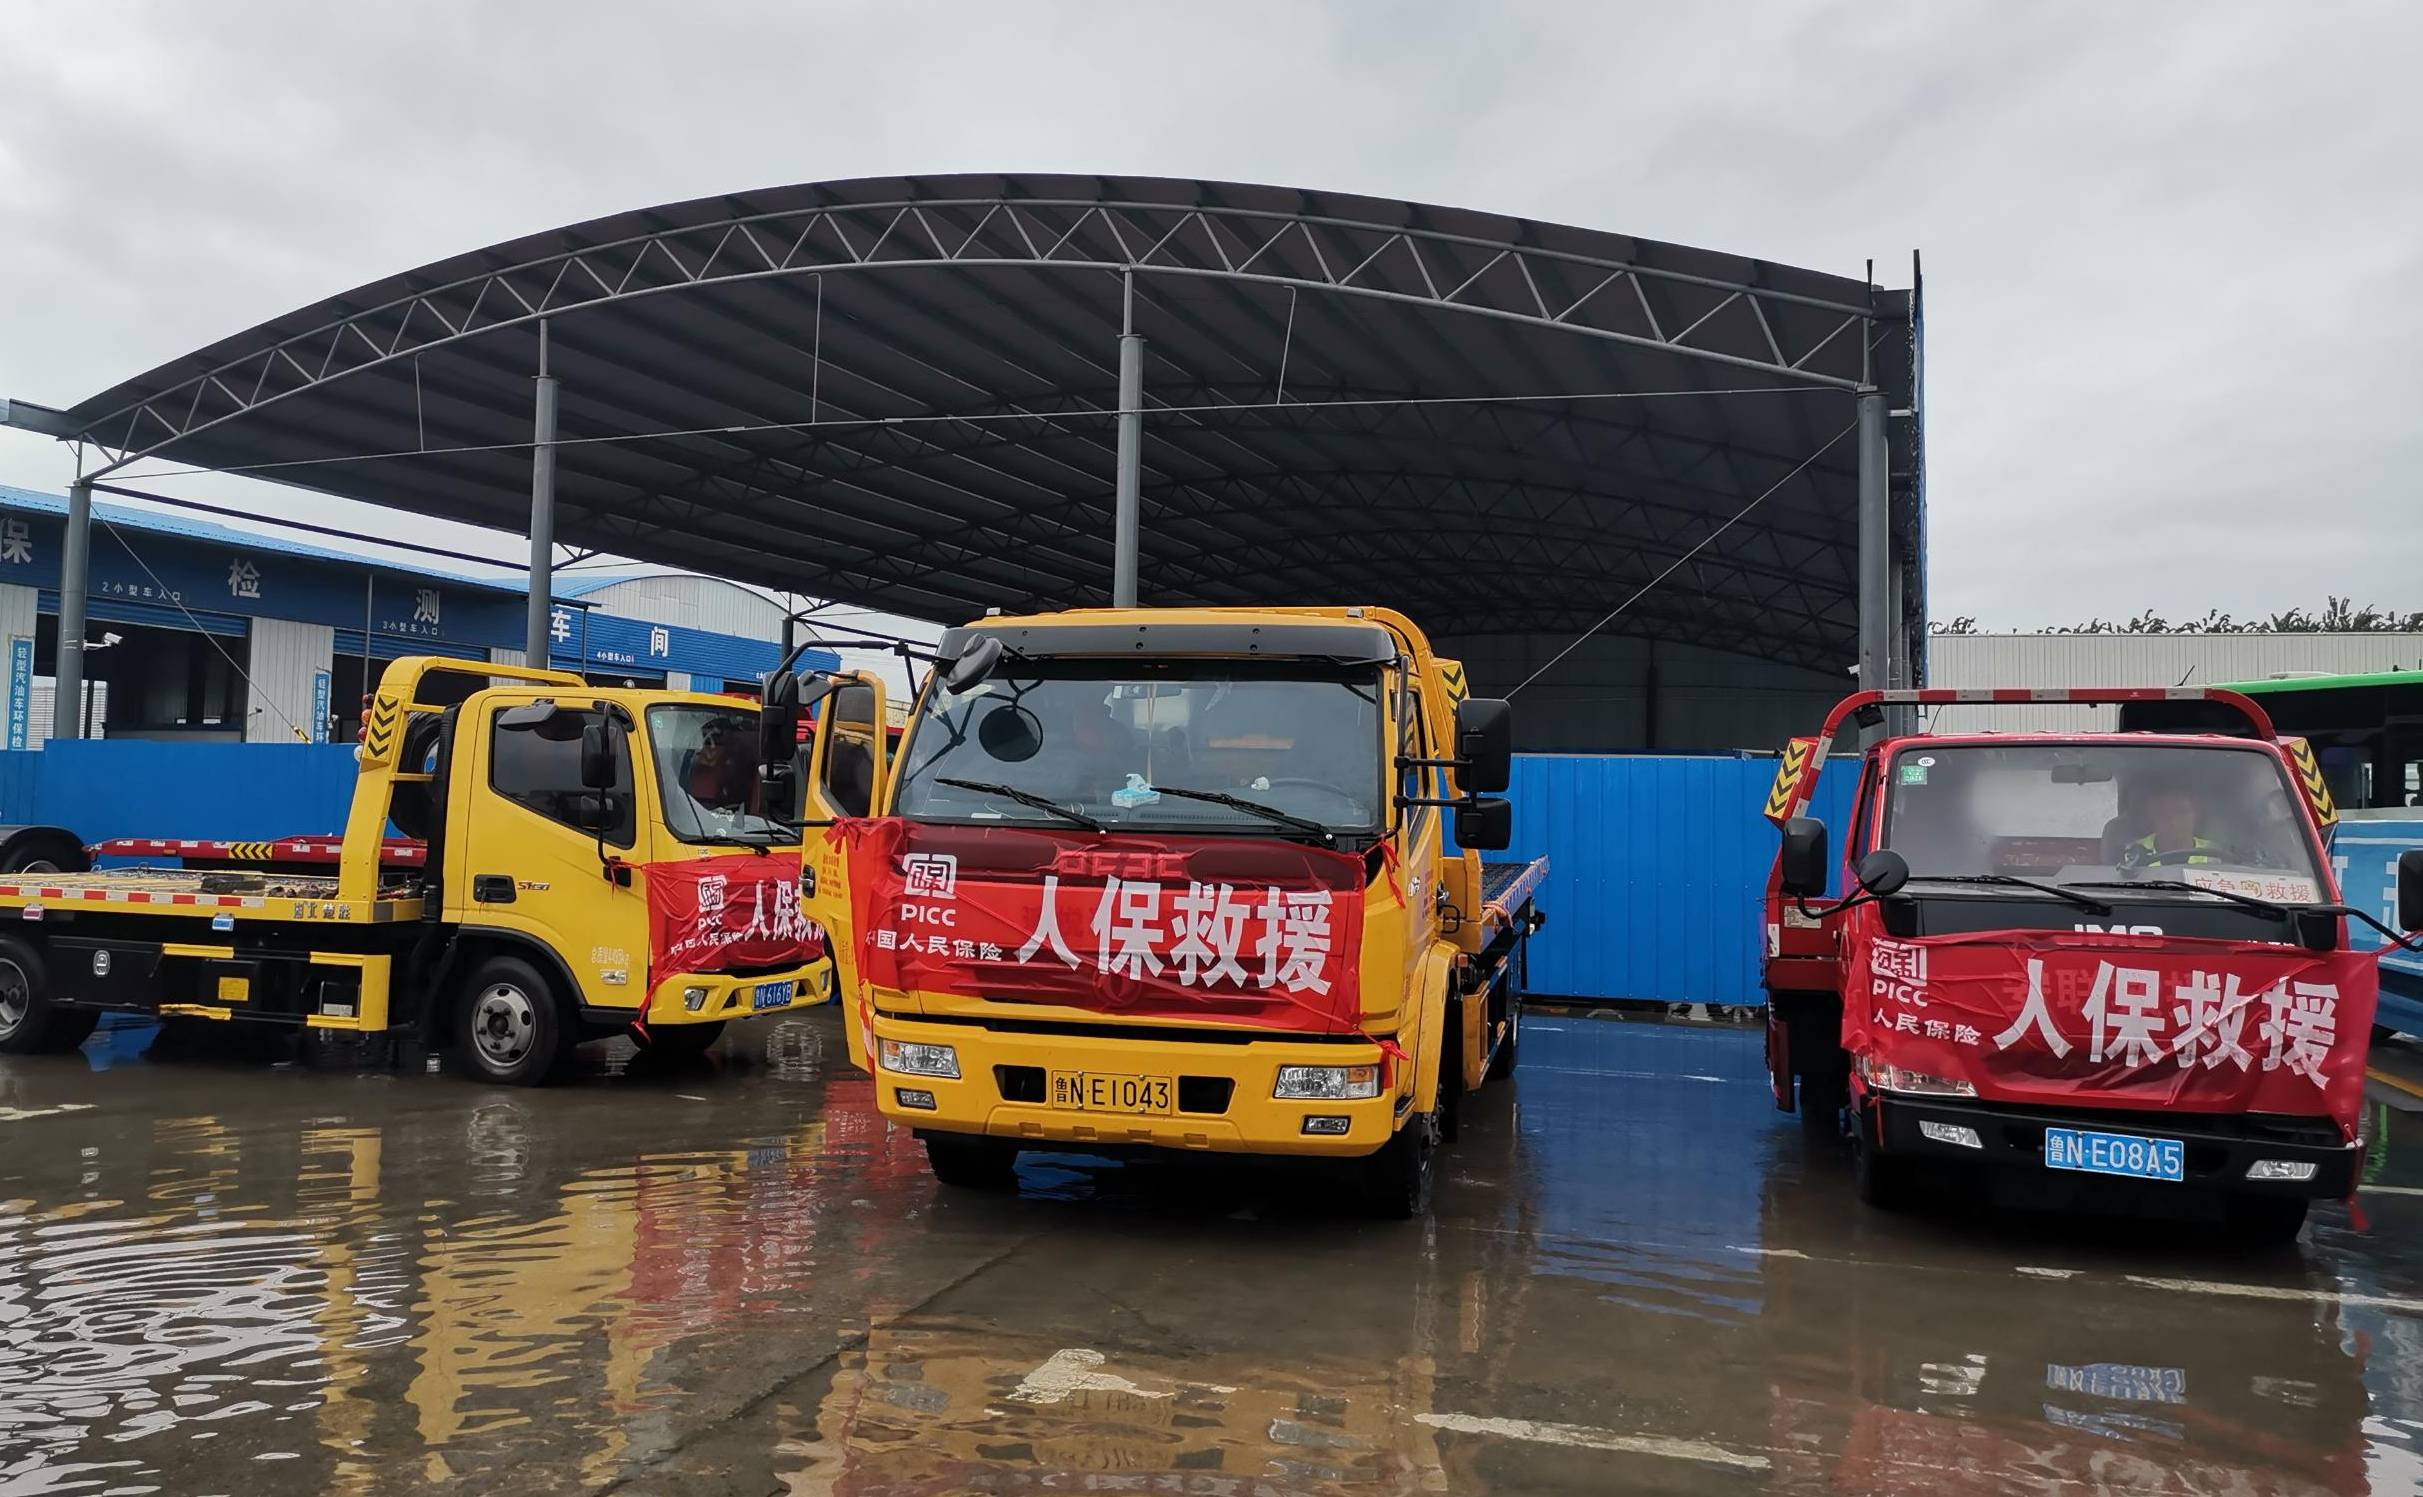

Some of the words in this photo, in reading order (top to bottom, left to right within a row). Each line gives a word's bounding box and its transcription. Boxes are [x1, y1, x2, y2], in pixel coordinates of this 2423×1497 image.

[228, 558, 261, 598] 检
[414, 589, 439, 624] 测
[551, 609, 571, 643] 车
[650, 626, 669, 657] 间
[901, 903, 957, 927] PICC
[1018, 875, 1332, 995] 人保救援
[1872, 978, 1929, 1007] PICC
[1992, 958, 2340, 1091] 人保救援
[1873, 1008, 1982, 1046] 人民保险
